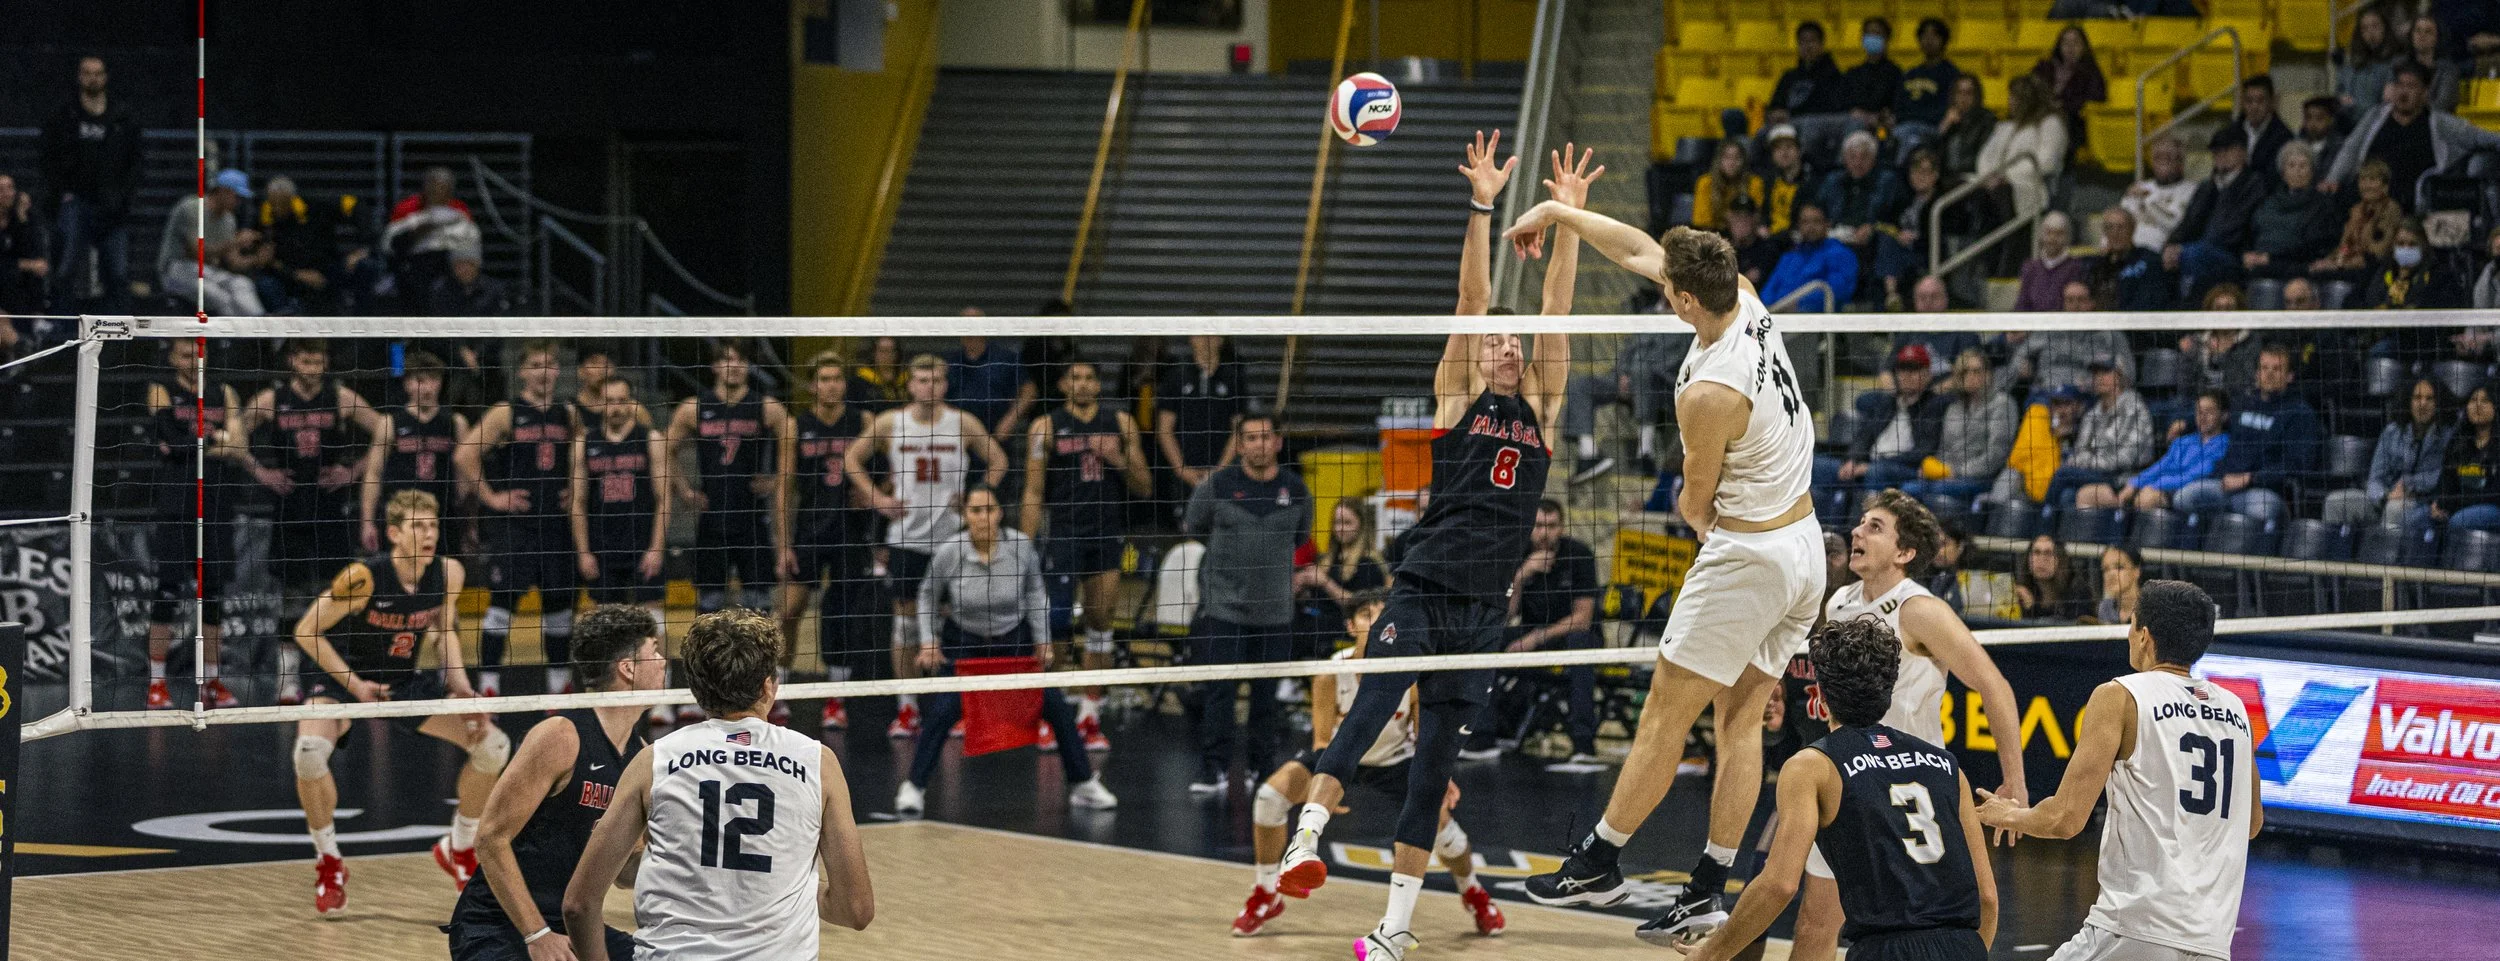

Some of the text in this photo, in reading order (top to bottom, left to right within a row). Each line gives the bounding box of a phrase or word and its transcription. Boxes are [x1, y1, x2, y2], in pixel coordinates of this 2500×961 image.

[1490, 446, 1521, 489] 8
[388, 632, 415, 659] 2
[2153, 702, 2249, 738] LONG BEACH
[668, 750, 806, 783] LONG BEACH
[1843, 751, 1952, 777] LONG BEACH
[2179, 731, 2234, 819] 31
[2365, 773, 2450, 802] Instant
[2448, 781, 2486, 805] Oil
[699, 779, 775, 873] 12
[1889, 781, 1945, 864] 3
